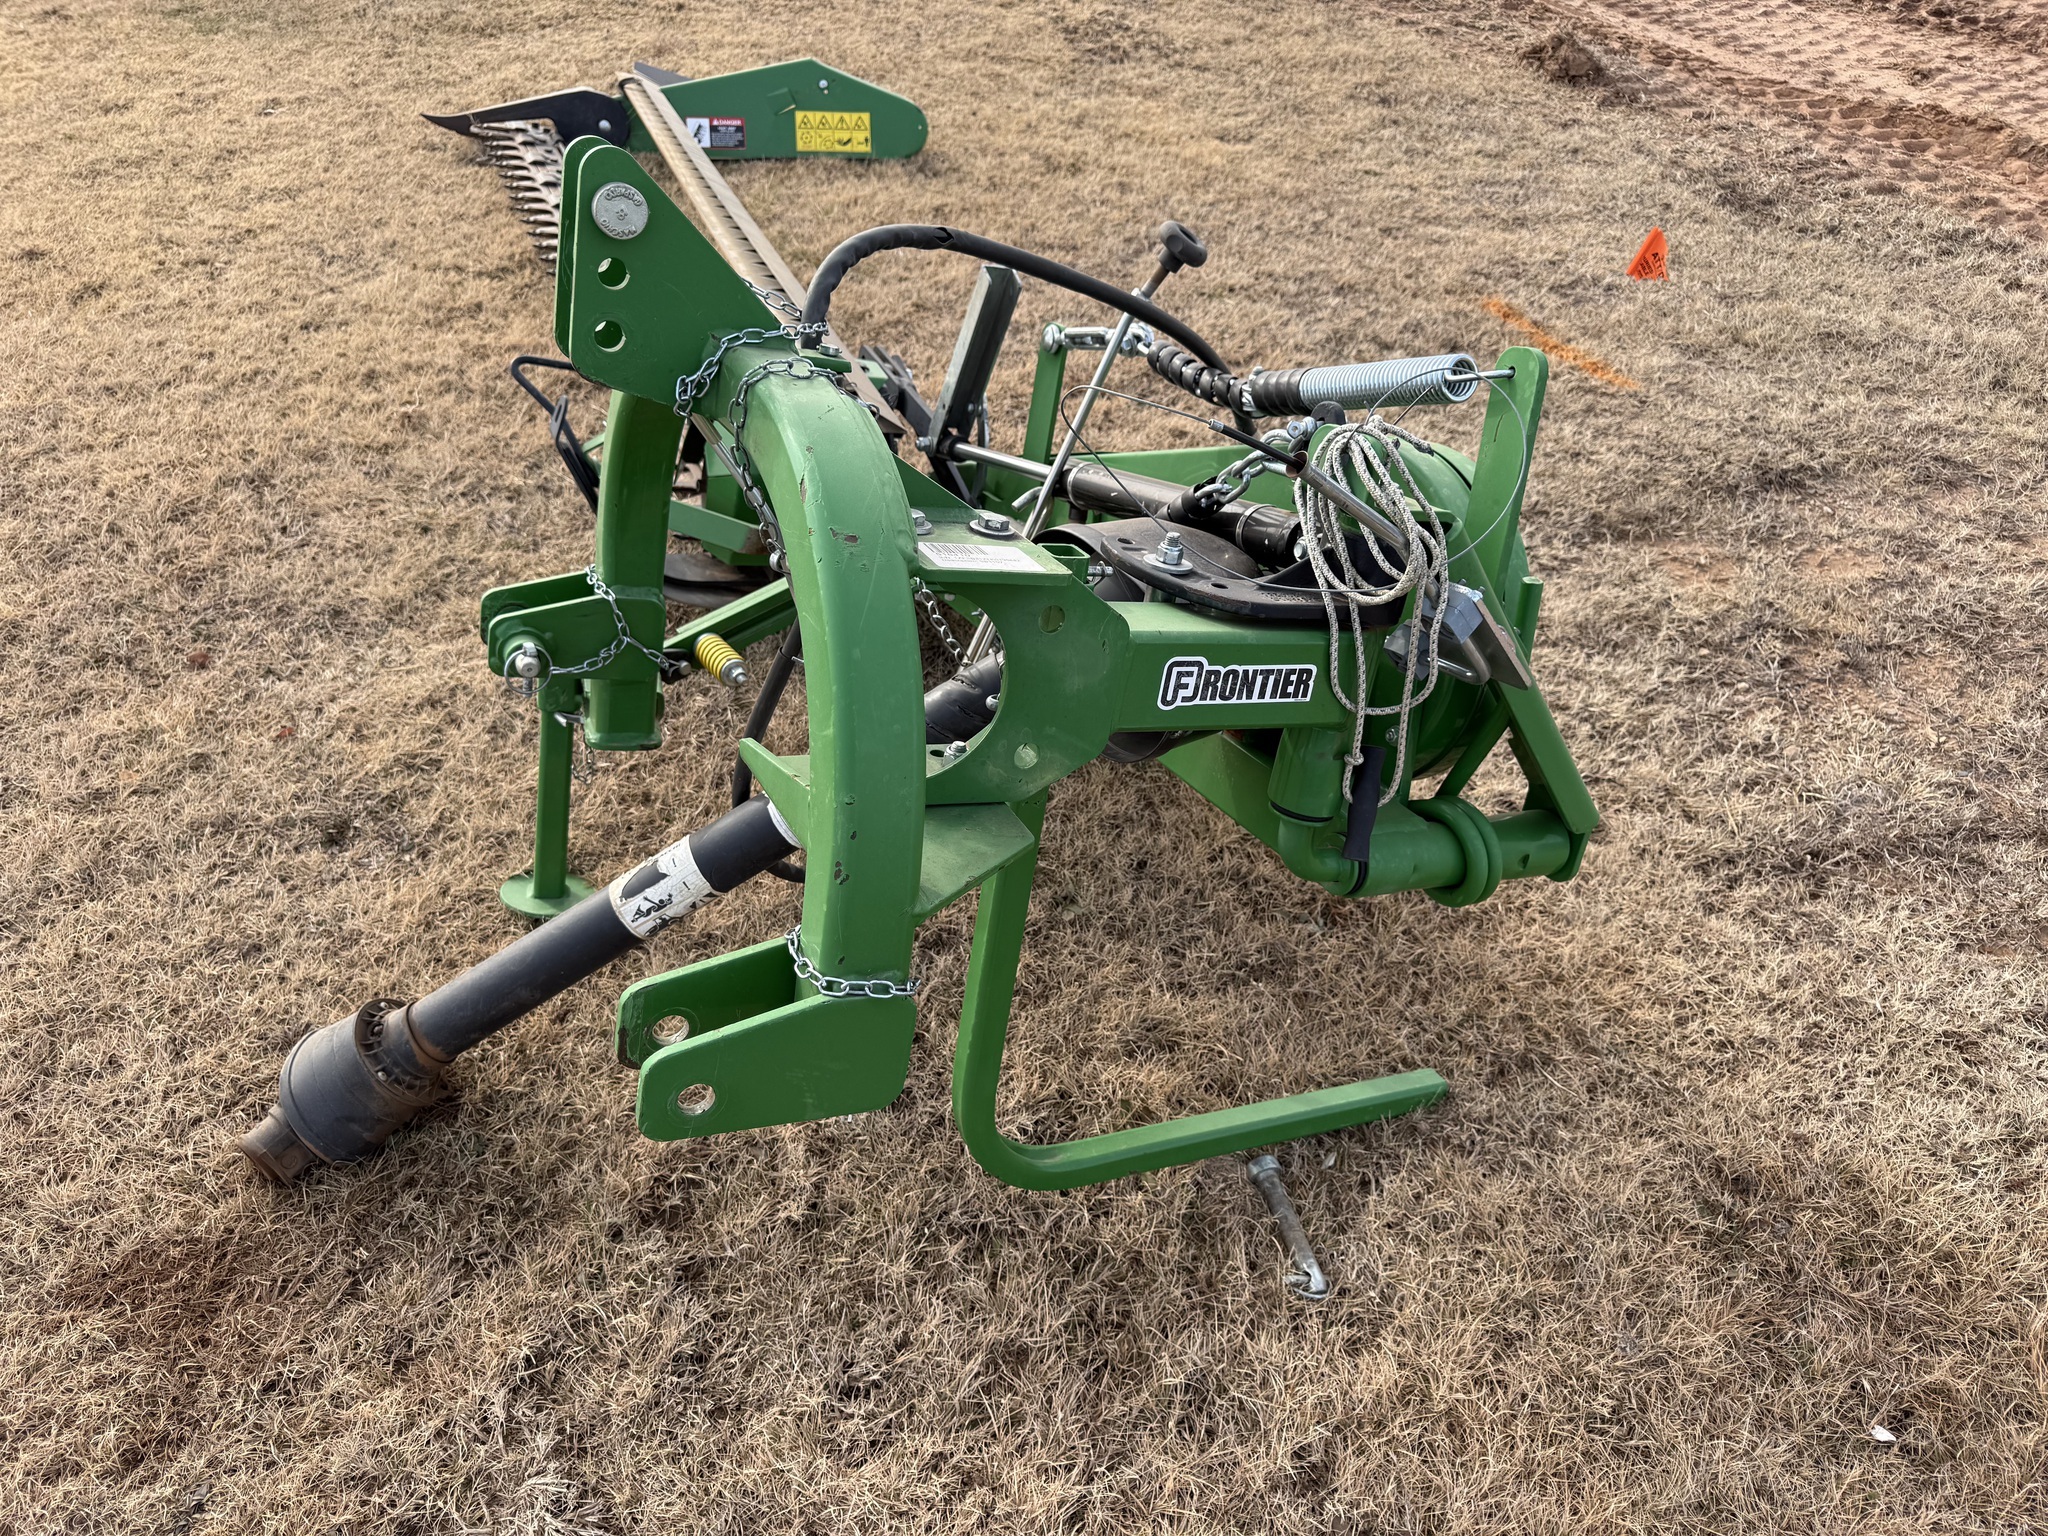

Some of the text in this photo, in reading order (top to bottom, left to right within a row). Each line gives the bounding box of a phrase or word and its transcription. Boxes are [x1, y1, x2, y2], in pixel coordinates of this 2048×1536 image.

[604, 188, 643, 206] GASPARDO
[600, 219, 637, 238] MASCHIO
[1160, 660, 1314, 707] FRONTIER
